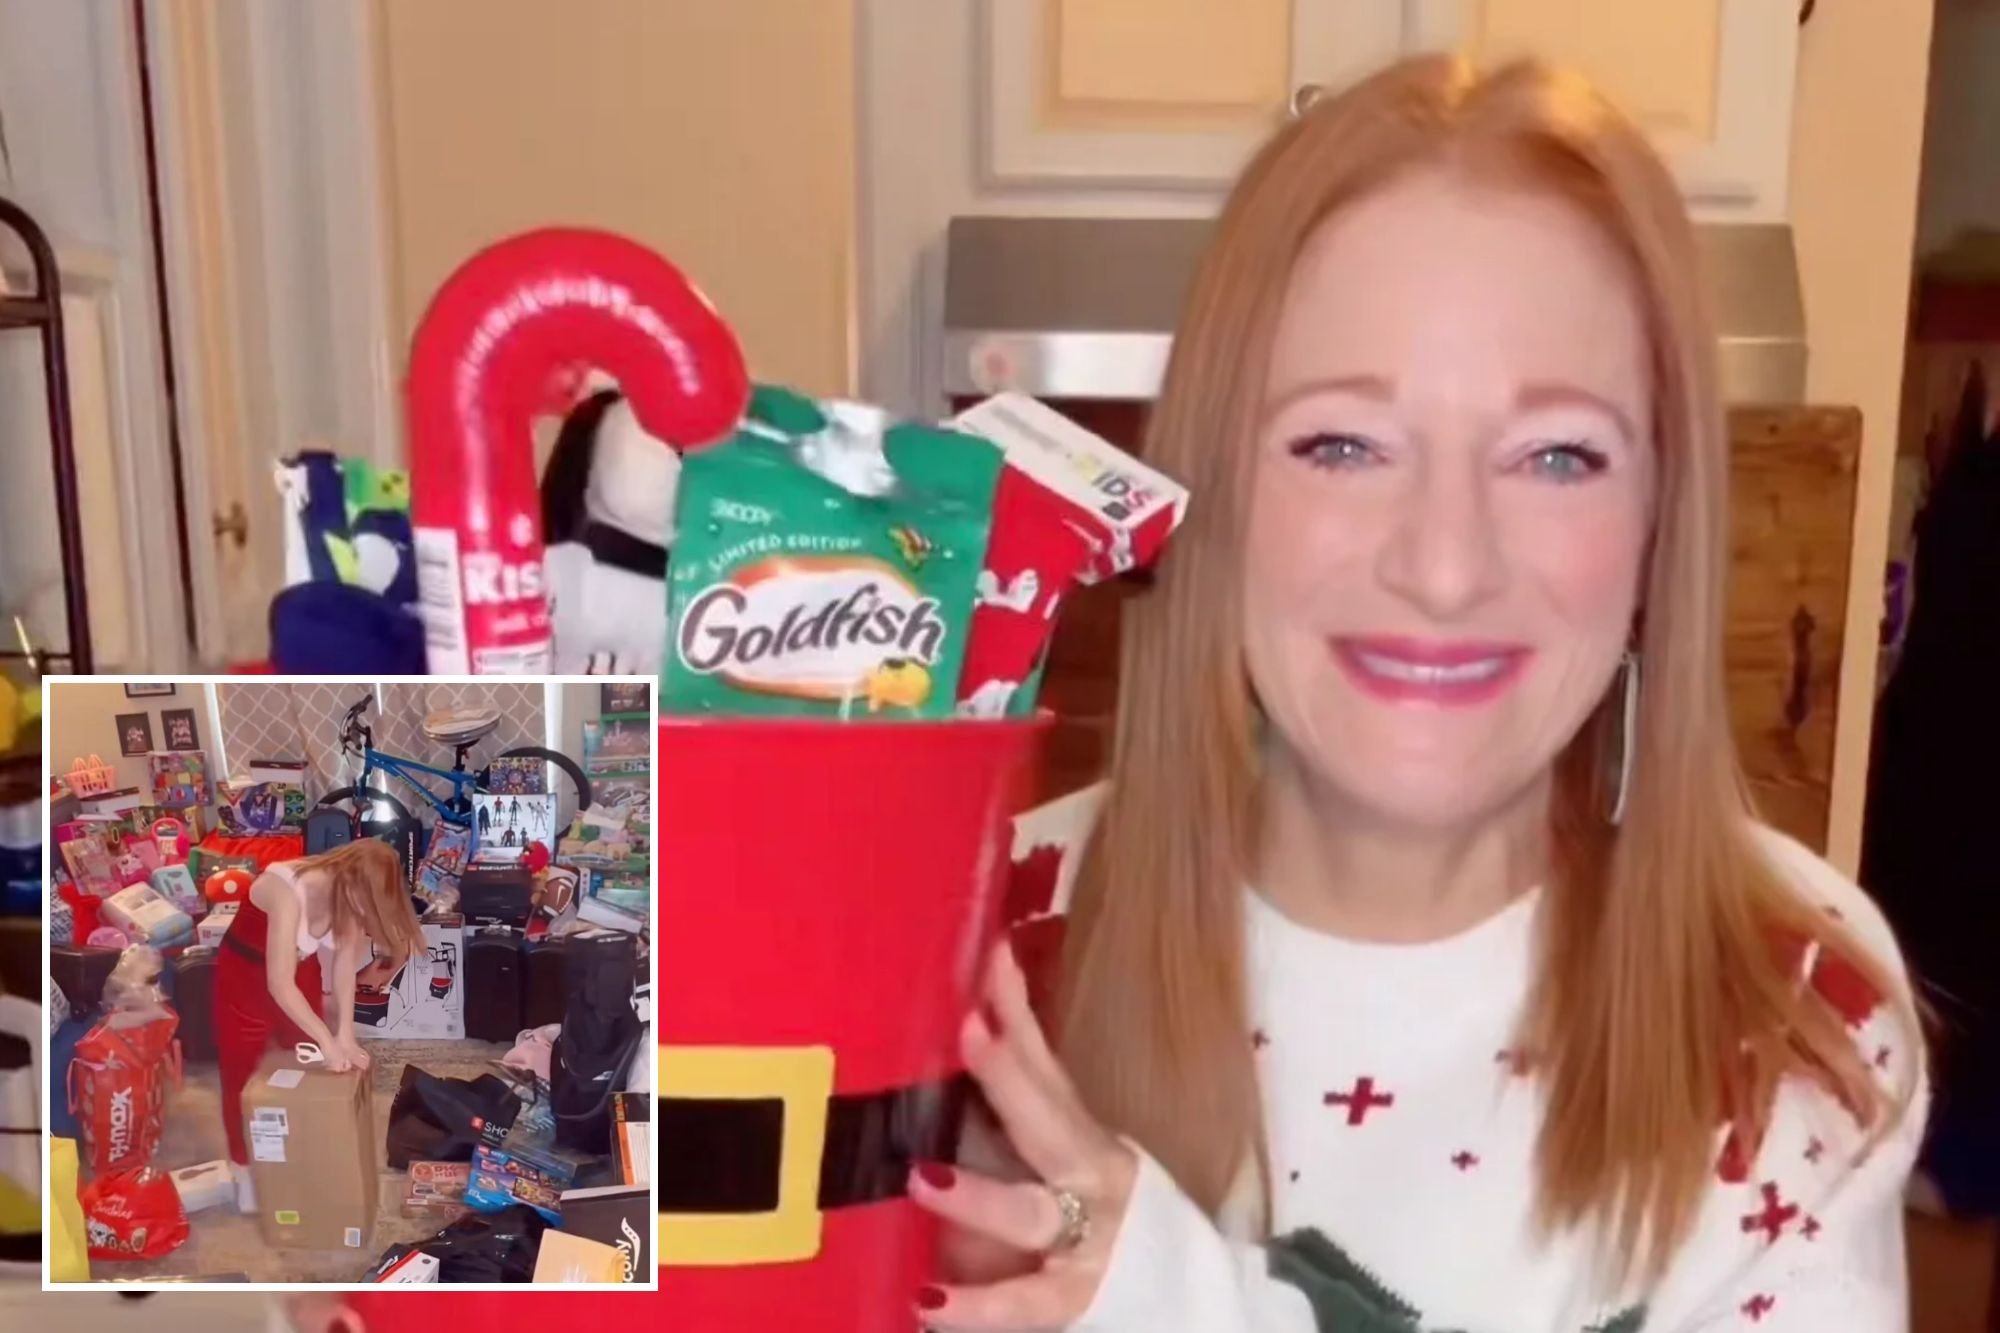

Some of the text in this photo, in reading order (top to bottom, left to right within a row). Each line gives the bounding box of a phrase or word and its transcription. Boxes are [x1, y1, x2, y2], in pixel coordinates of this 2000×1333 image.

[708, 534, 782, 572] LIMITED
[786, 534, 863, 551] EDITION
[679, 583, 944, 672] Goldfish
